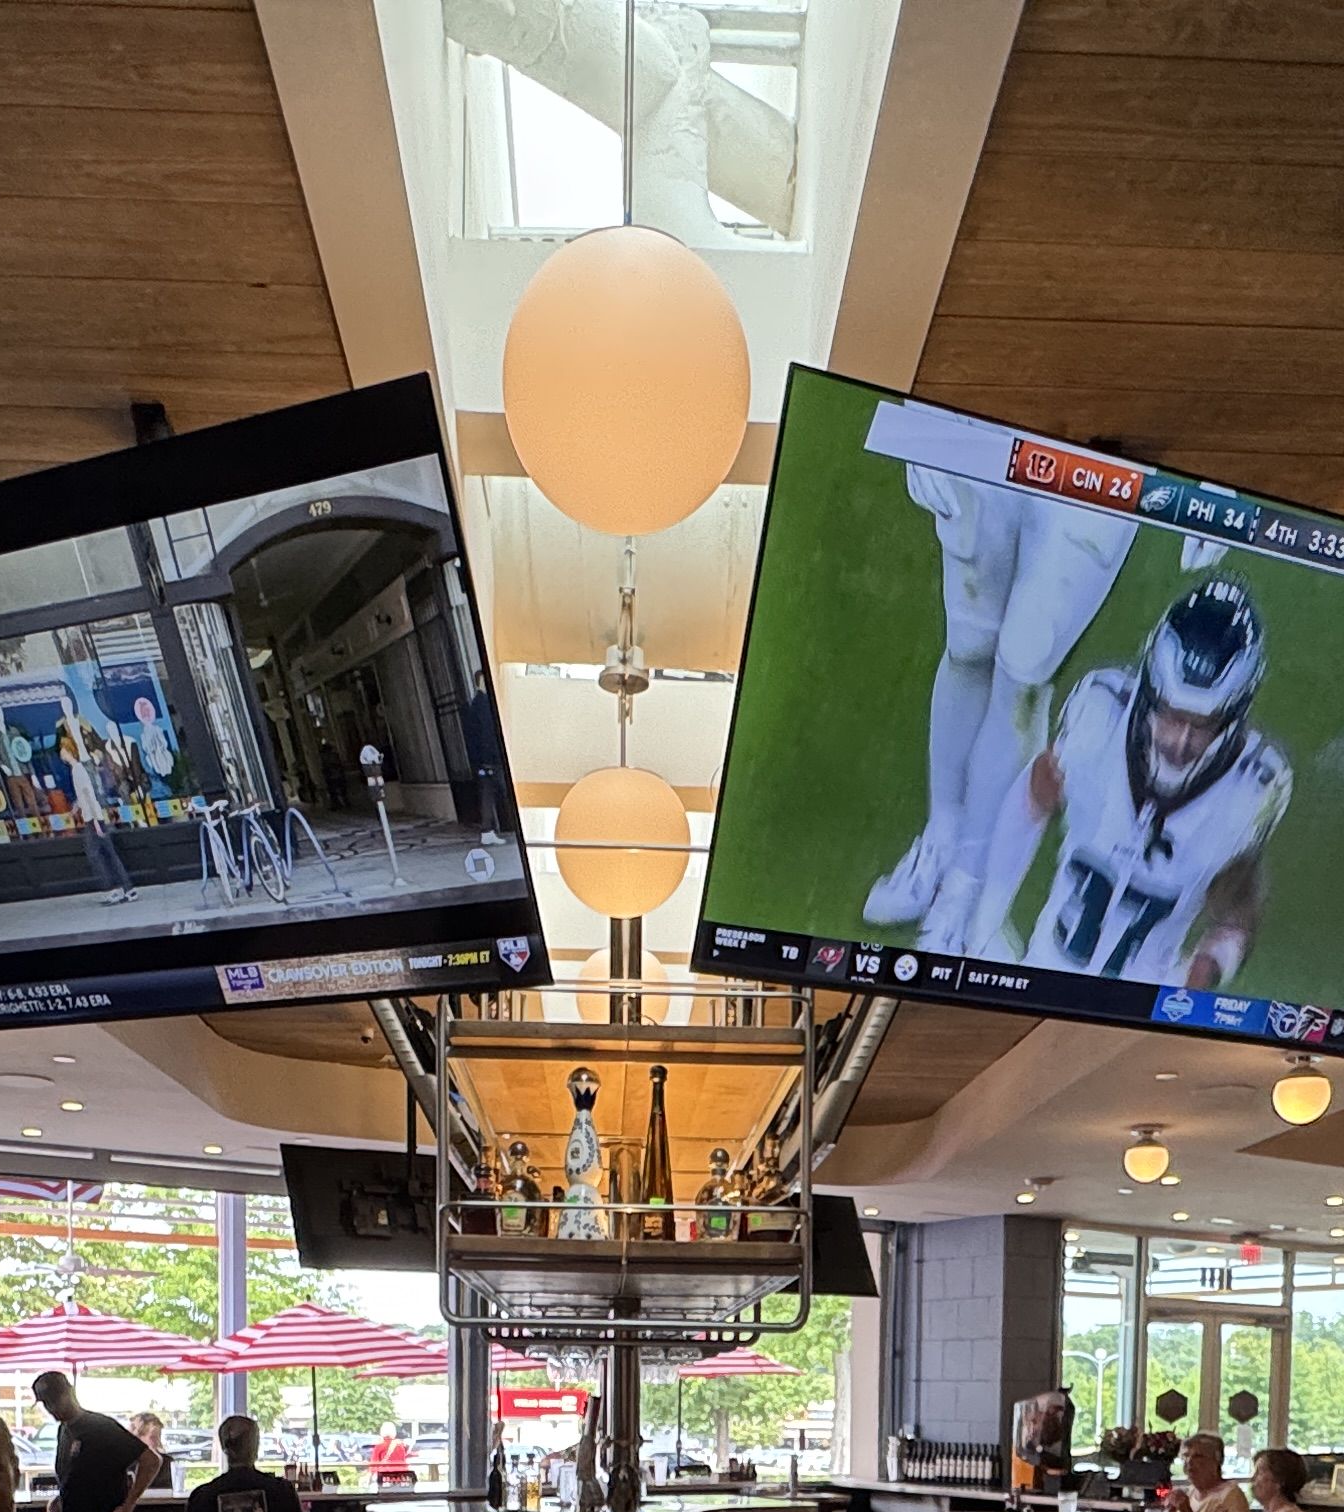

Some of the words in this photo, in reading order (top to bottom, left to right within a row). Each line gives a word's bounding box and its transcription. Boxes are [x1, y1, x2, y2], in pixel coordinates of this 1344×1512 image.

[1071, 467, 1104, 493] CIN
[1108, 476, 1132, 500] 26
[1186, 498, 1215, 524] PHI
[1223, 507, 1246, 530] 34
[1264, 519, 1298, 547] 4TH
[479, 950, 490, 963] ET
[781, 945, 799, 960] TB
[351, 958, 403, 976] EDITION
[855, 953, 881, 974] VS
[226, 966, 259, 980] MLB
[930, 966, 953, 981] PIT
[968, 971, 990, 984] SAT
[990, 974, 999, 985] 7
[49, 984, 71, 997] ERA
[88, 994, 112, 1007] ERA
[1214, 997, 1251, 1014] FRIDAY
